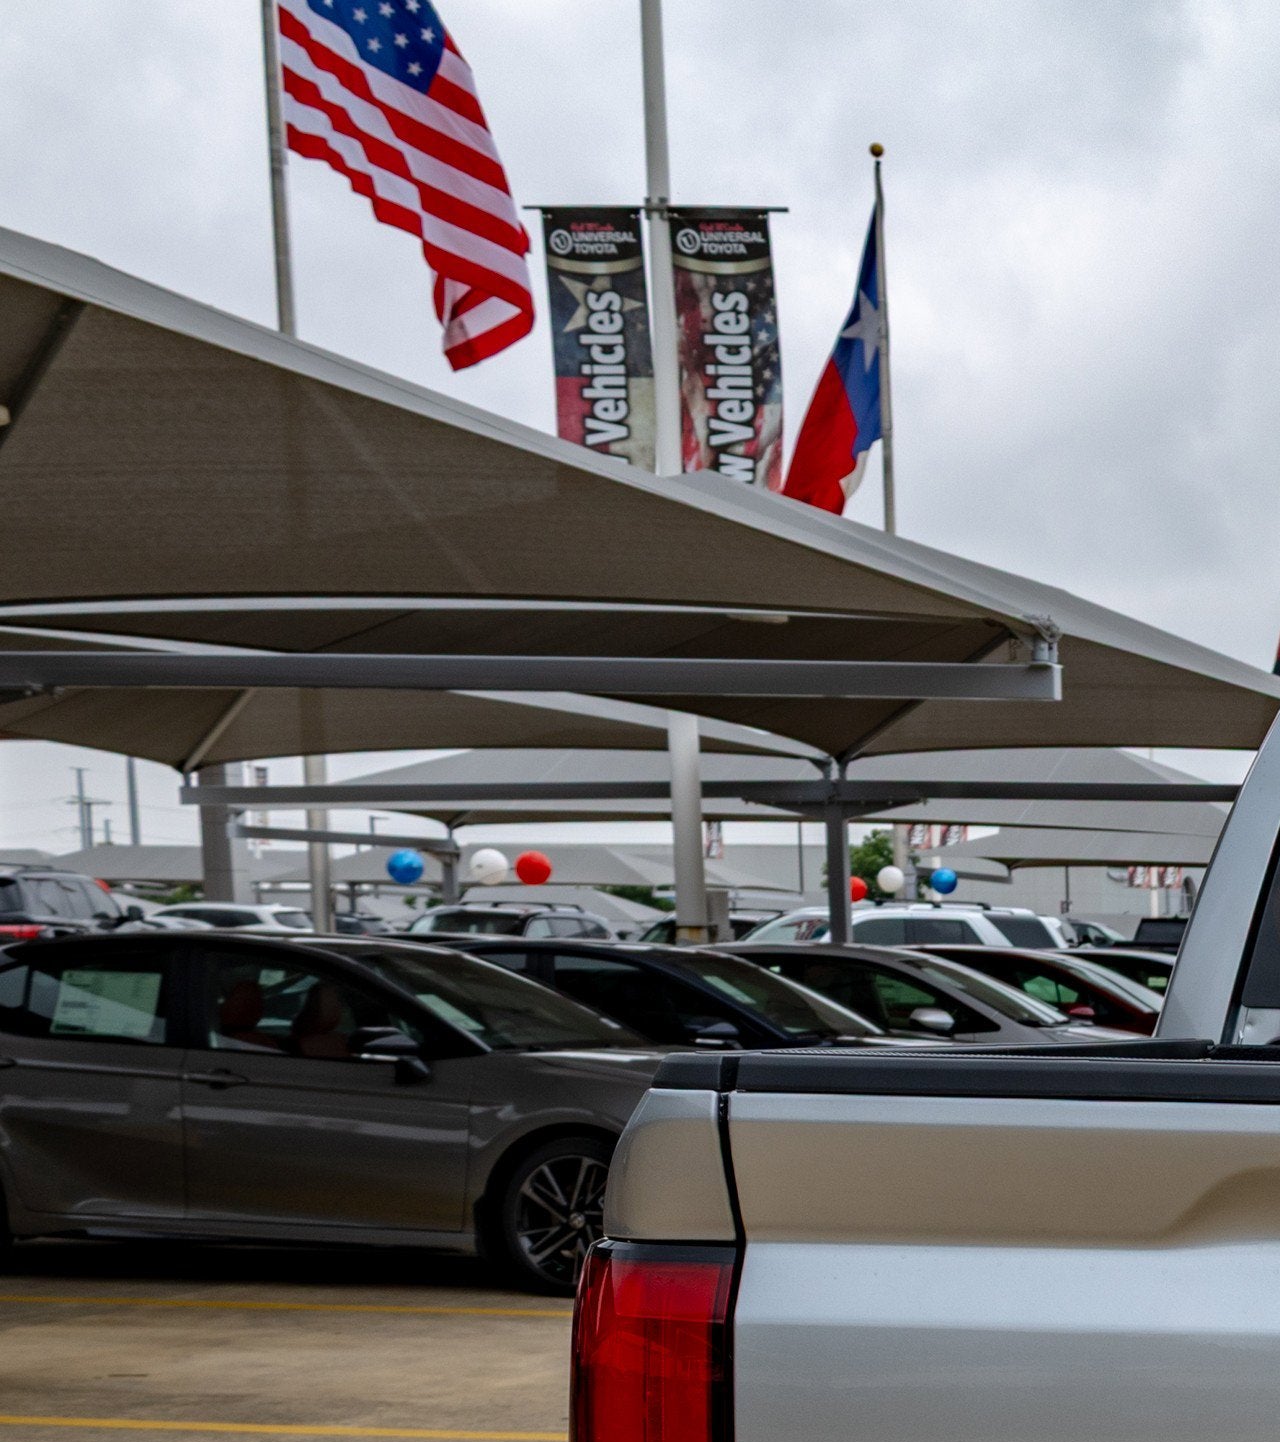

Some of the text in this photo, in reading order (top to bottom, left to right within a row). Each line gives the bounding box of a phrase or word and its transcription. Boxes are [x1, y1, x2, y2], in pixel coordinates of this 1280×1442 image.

[572, 231, 637, 243] UNIVERSAL
[700, 231, 766, 243] UNIVERSAL
[573, 243, 618, 254] TOYOTA
[702, 243, 747, 255] TOYOTA
[579, 291, 629, 446] Vehicles
[703, 291, 755, 447] Vehicles
